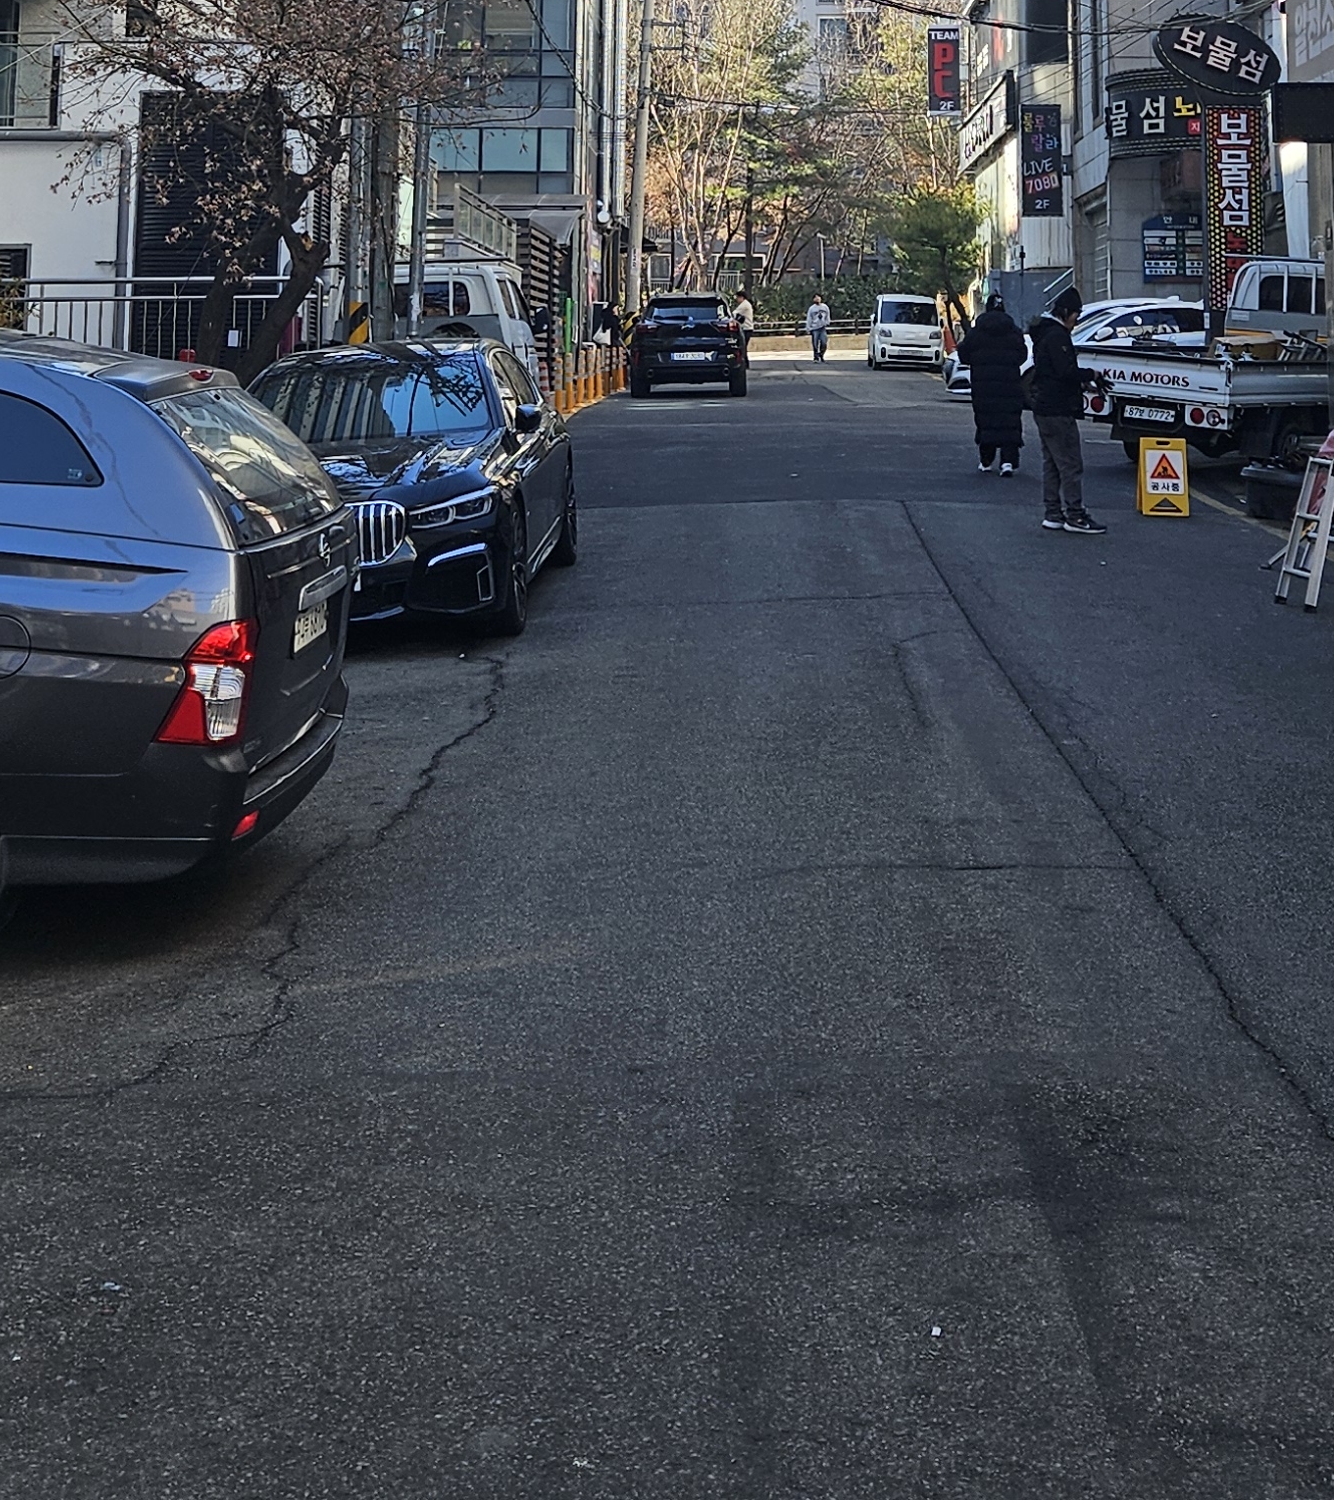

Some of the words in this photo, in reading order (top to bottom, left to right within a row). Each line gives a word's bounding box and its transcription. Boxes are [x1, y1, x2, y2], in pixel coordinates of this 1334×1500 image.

[929, 31, 958, 40] TEAM
[1173, 26, 1269, 84] 보물섬
[933, 43, 953, 98] PC
[939, 100, 954, 110] 2F
[1023, 157, 1053, 176] LIVE
[1217, 112, 1253, 227] 보물섬
[1025, 174, 1058, 194] 7080
[1035, 199, 1050, 210] 2F
[1102, 368, 1126, 381] KIA
[1130, 371, 1190, 388] MOTORS
[1148, 409, 1171, 421] 0772
[1150, 481, 1180, 493] 공사중
